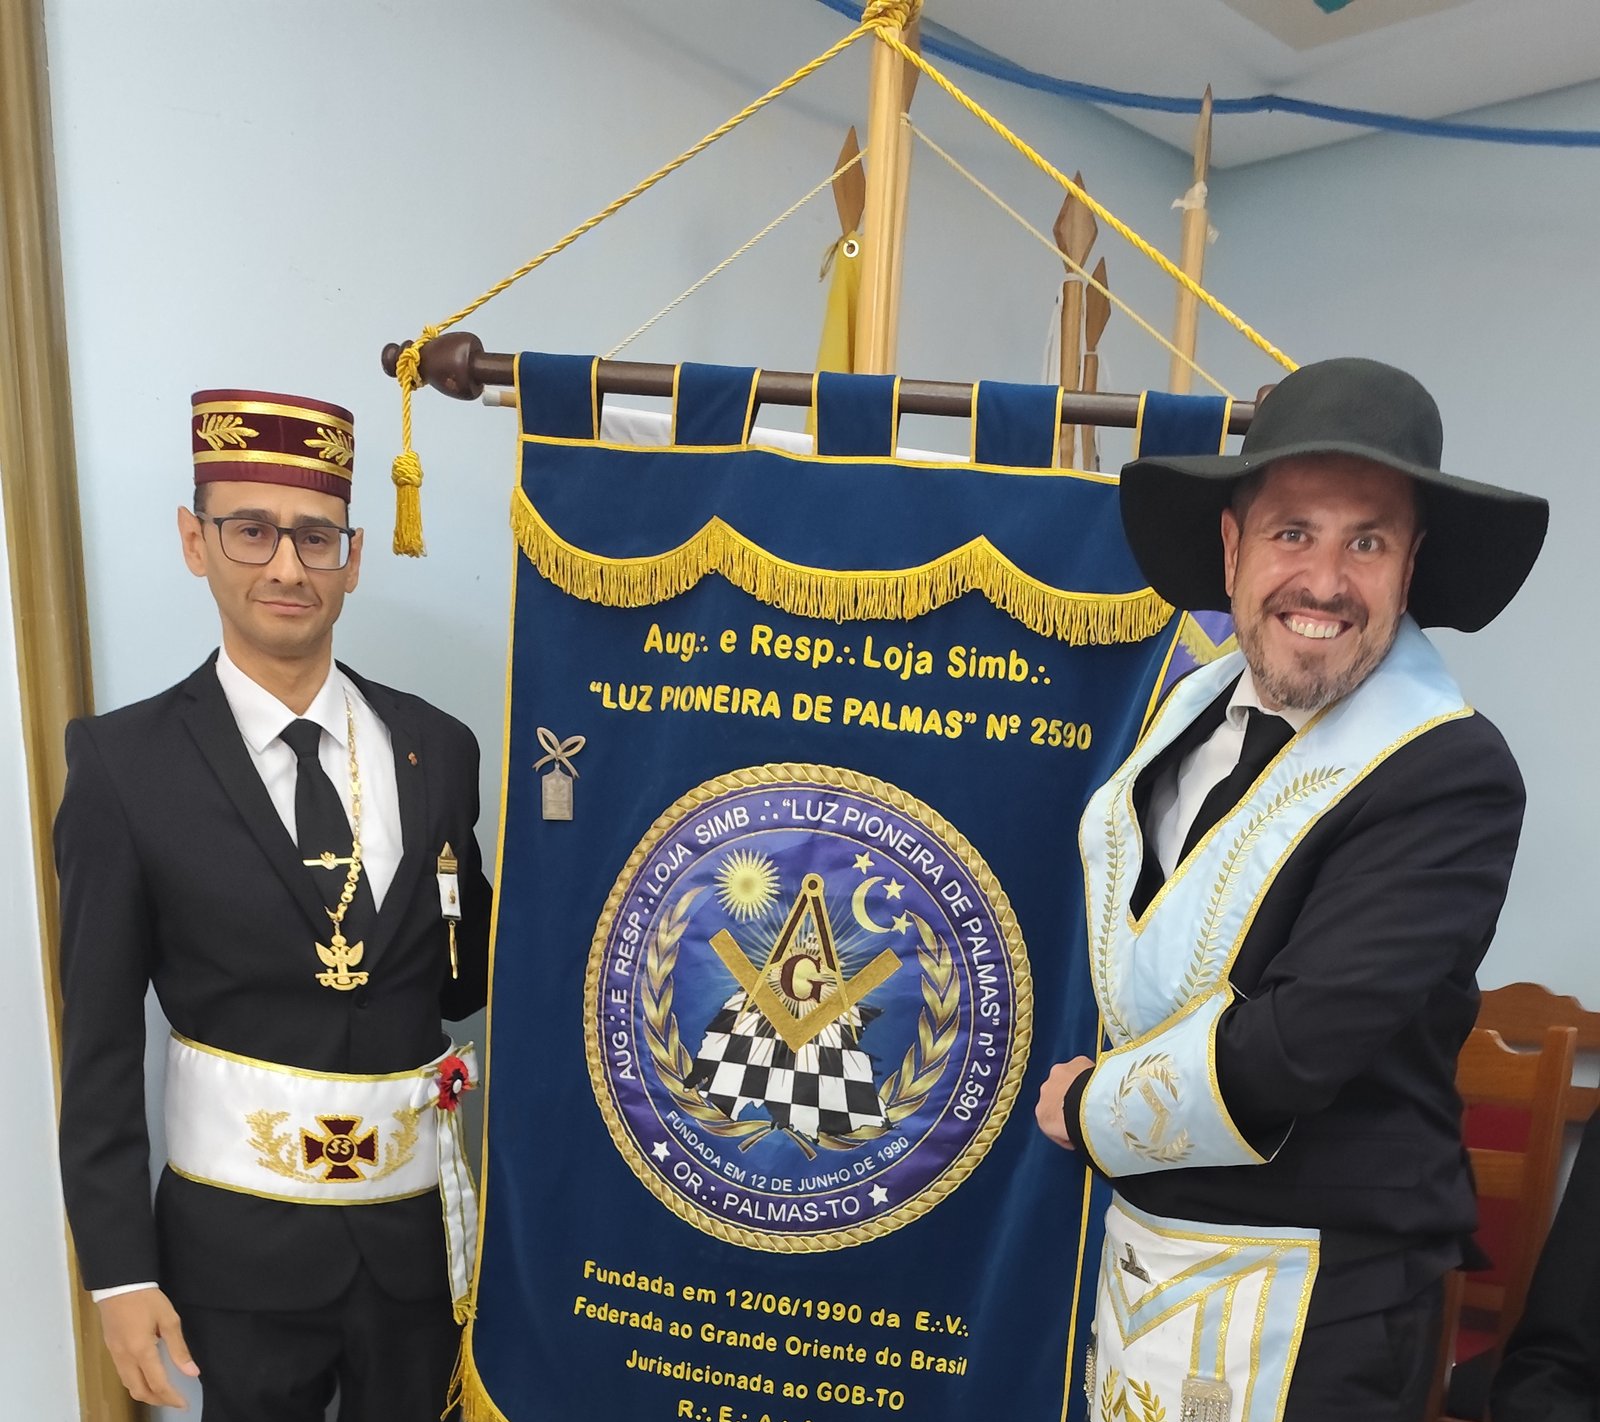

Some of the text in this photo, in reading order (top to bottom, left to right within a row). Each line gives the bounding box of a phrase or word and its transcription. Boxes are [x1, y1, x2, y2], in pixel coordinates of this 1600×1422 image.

[720, 629, 738, 653] e
[863, 635, 933, 680] Loja
[660, 685, 781, 719] PIONEIRA
[792, 693, 833, 724] DE
[843, 697, 977, 739] PALMAS”
[986, 714, 1021, 741] Nº
[1030, 717, 1092, 750] 2590
[647, 843, 692, 896] LOJA
[842, 806, 945, 885] PIONEIRA
[941, 887, 973, 918] DE
[611, 989, 627, 1004] E
[779, 955, 826, 1003] G
[953, 1061, 992, 1122] 2.590
[666, 1110, 909, 1192] FUNDADA EM 12 DE JUNHO DE 1990
[722, 1192, 860, 1223] PALMAS-TO
[583, 1260, 675, 1298] Fundada
[682, 1287, 717, 1305] em
[725, 1288, 862, 1324] 12/06/1990
[869, 1308, 901, 1328] da
[573, 1296, 968, 1376] Federada ao Grande Oriente do Brasil
[625, 1349, 905, 1411] Jurisdicionada ao GOB-TO
